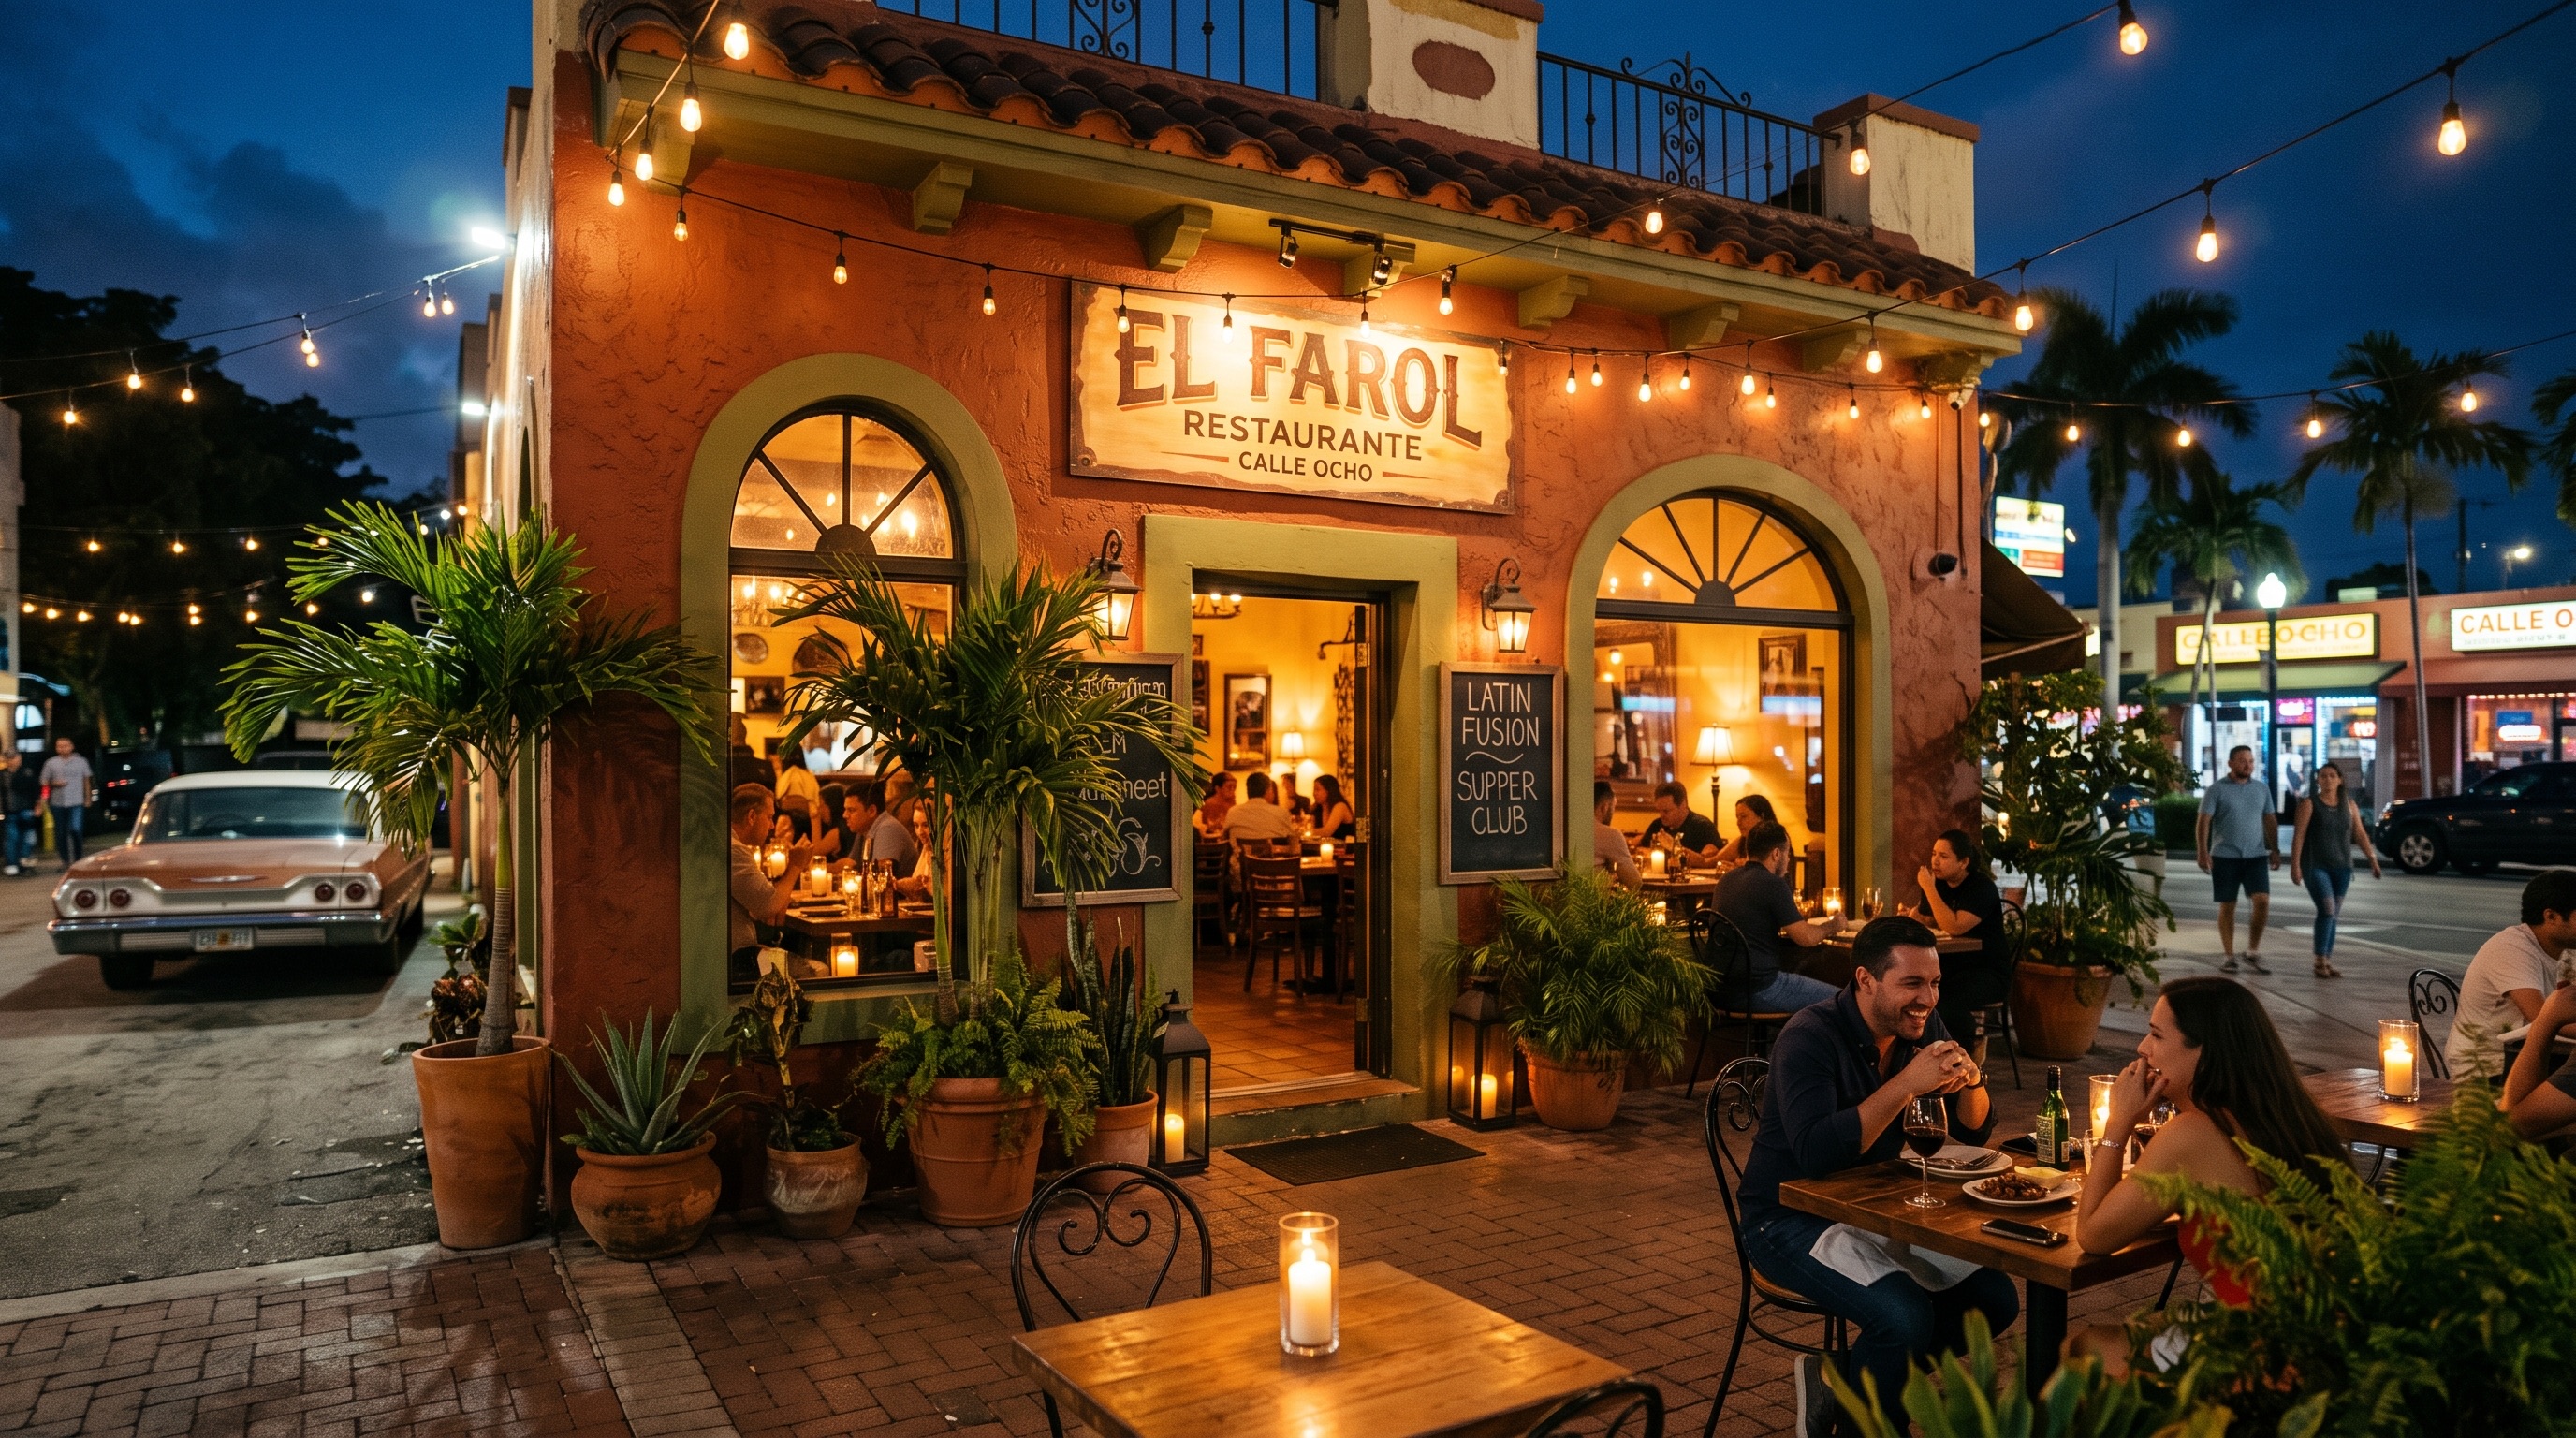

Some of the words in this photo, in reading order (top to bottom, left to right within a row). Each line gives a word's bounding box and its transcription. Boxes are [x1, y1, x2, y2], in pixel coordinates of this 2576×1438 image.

[1113, 308, 1217, 409] EL
[1249, 325, 1482, 450] FAROL
[1184, 410, 1422, 462] RESTAURANTE
[1238, 451, 1306, 477] CALLE
[1313, 459, 1372, 482] OCHO
[2276, 621, 2366, 643] OCHO
[2460, 610, 2544, 634] CALLE
[1468, 682, 1531, 712] LATIN
[1462, 716, 1539, 746] FUSION
[1457, 770, 1538, 801] SUPPER
[1471, 805, 1528, 835] CLUB
